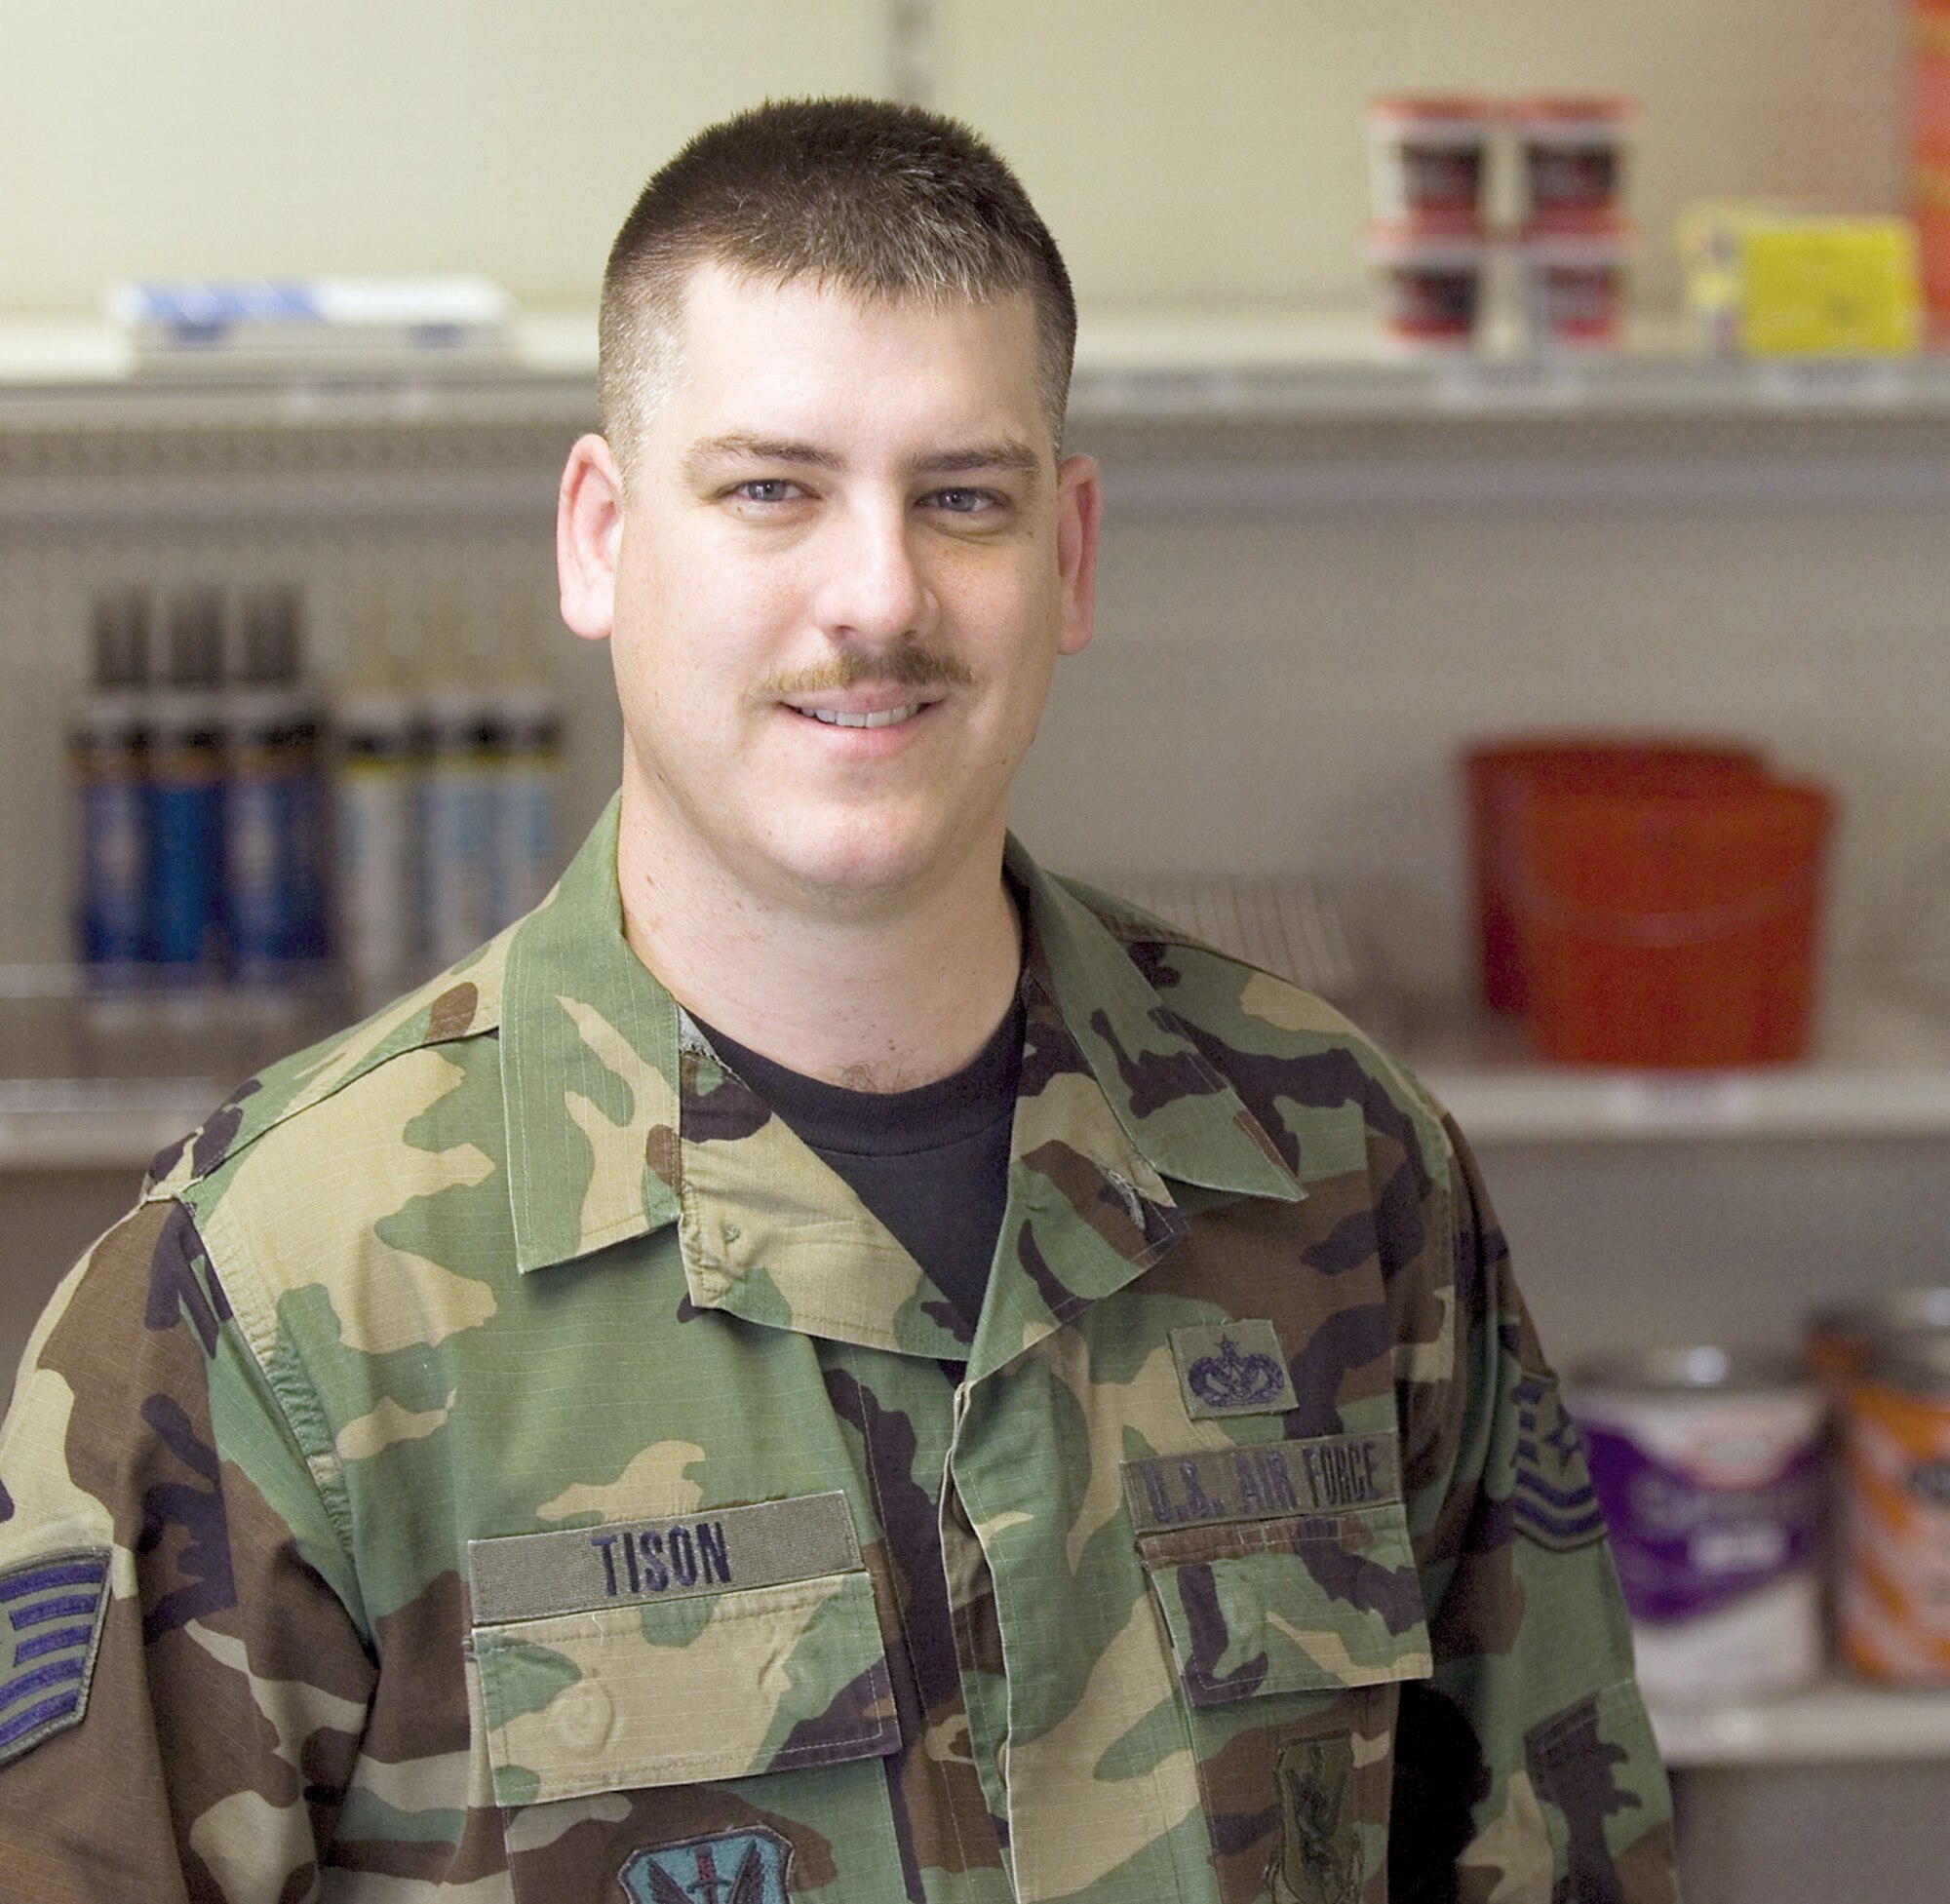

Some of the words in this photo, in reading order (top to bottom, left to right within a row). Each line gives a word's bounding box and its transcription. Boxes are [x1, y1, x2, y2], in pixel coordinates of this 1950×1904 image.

[1234, 1451, 1299, 1512] AIR
[1303, 1442, 1381, 1507] FORCE
[592, 1522, 731, 1595] TISON
